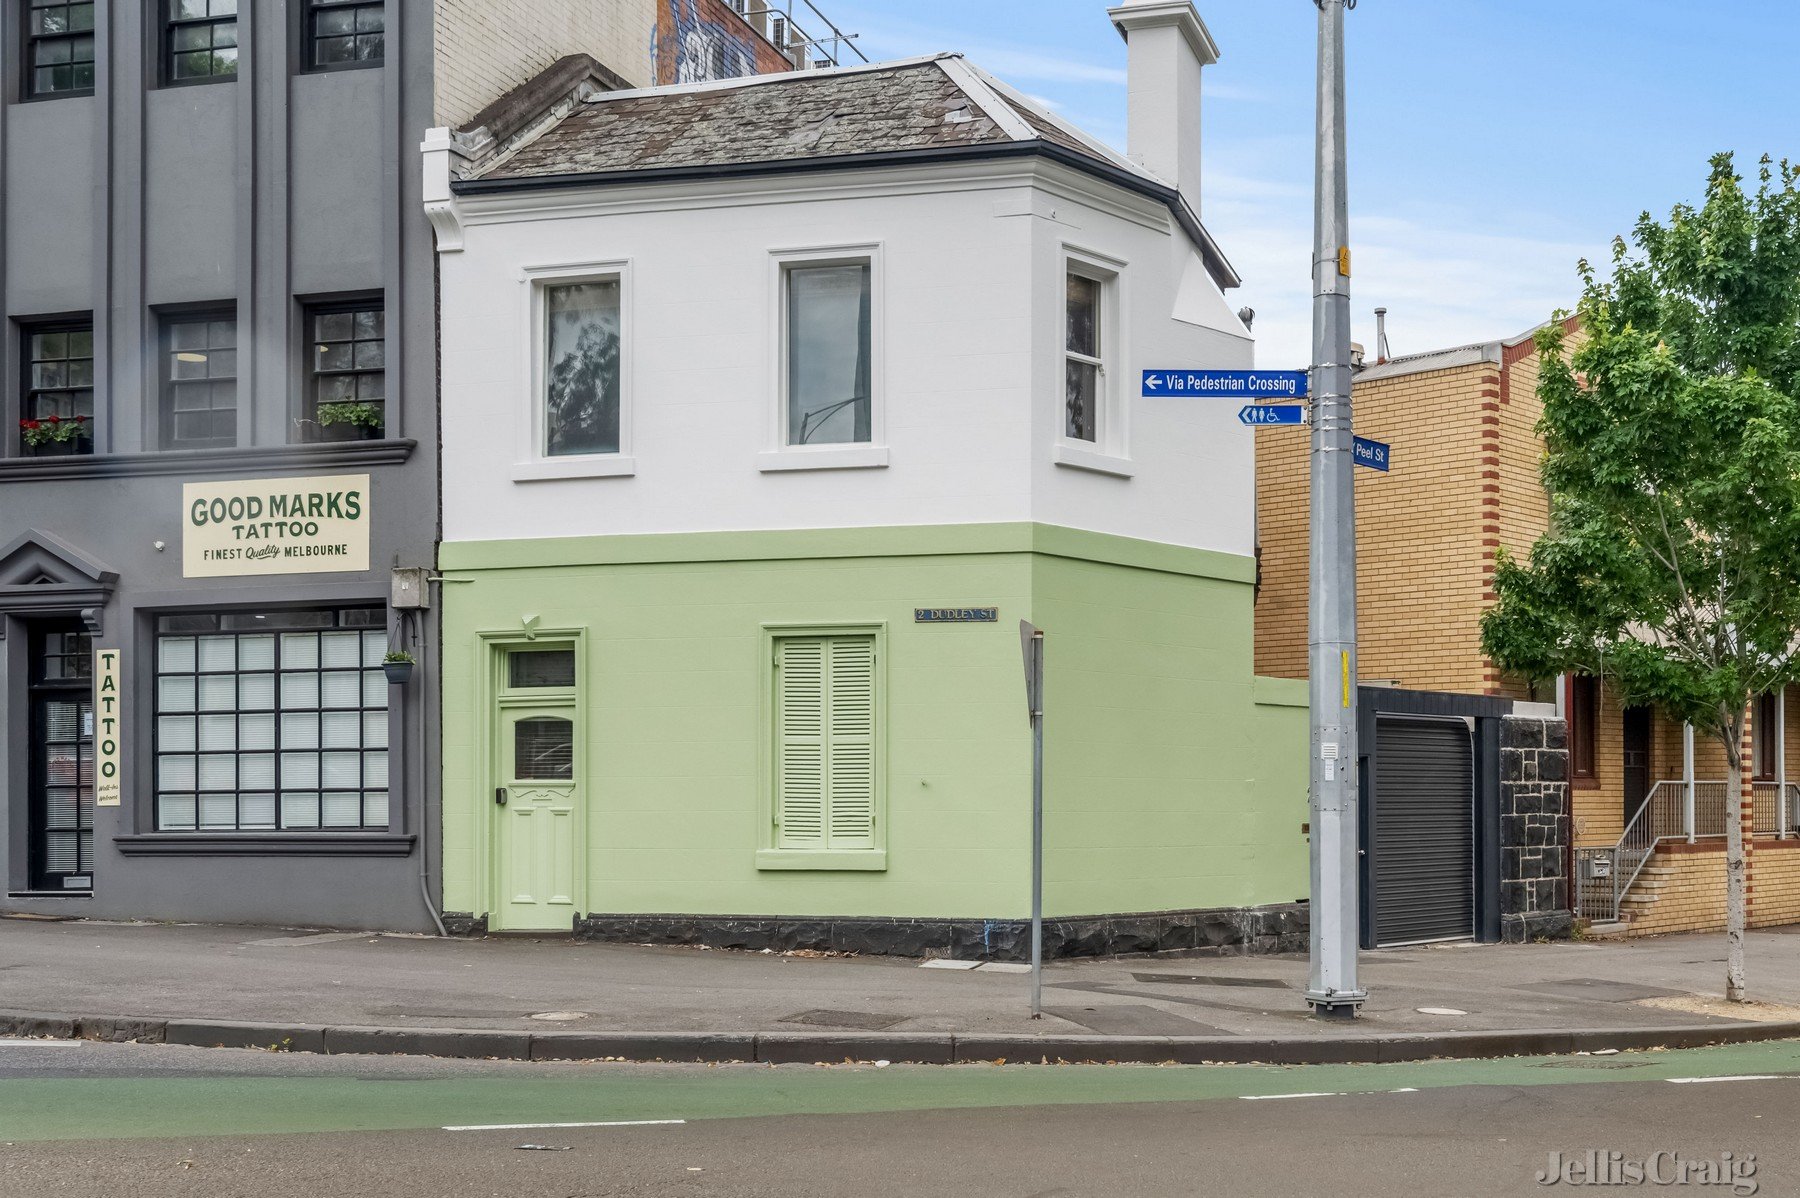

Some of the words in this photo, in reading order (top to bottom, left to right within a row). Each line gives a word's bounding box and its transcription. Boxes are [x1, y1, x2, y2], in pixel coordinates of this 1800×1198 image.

[1166, 375, 1184, 390] Via
[1188, 375, 1245, 390] Pedestrian
[1248, 375, 1296, 394] Crossing
[1356, 443, 1373, 460] Peel
[1375, 448, 1384, 462] St
[191, 496, 263, 526] GOOD
[269, 491, 361, 520] MARKS
[232, 522, 319, 539] TATTOO
[204, 548, 242, 560] FINEST
[245, 544, 280, 560] Quality
[284, 544, 348, 557] MELBOURNE
[931, 609, 977, 619] DUDLEY
[980, 609, 994, 618] ST
[101, 653, 116, 778] TATTOO
